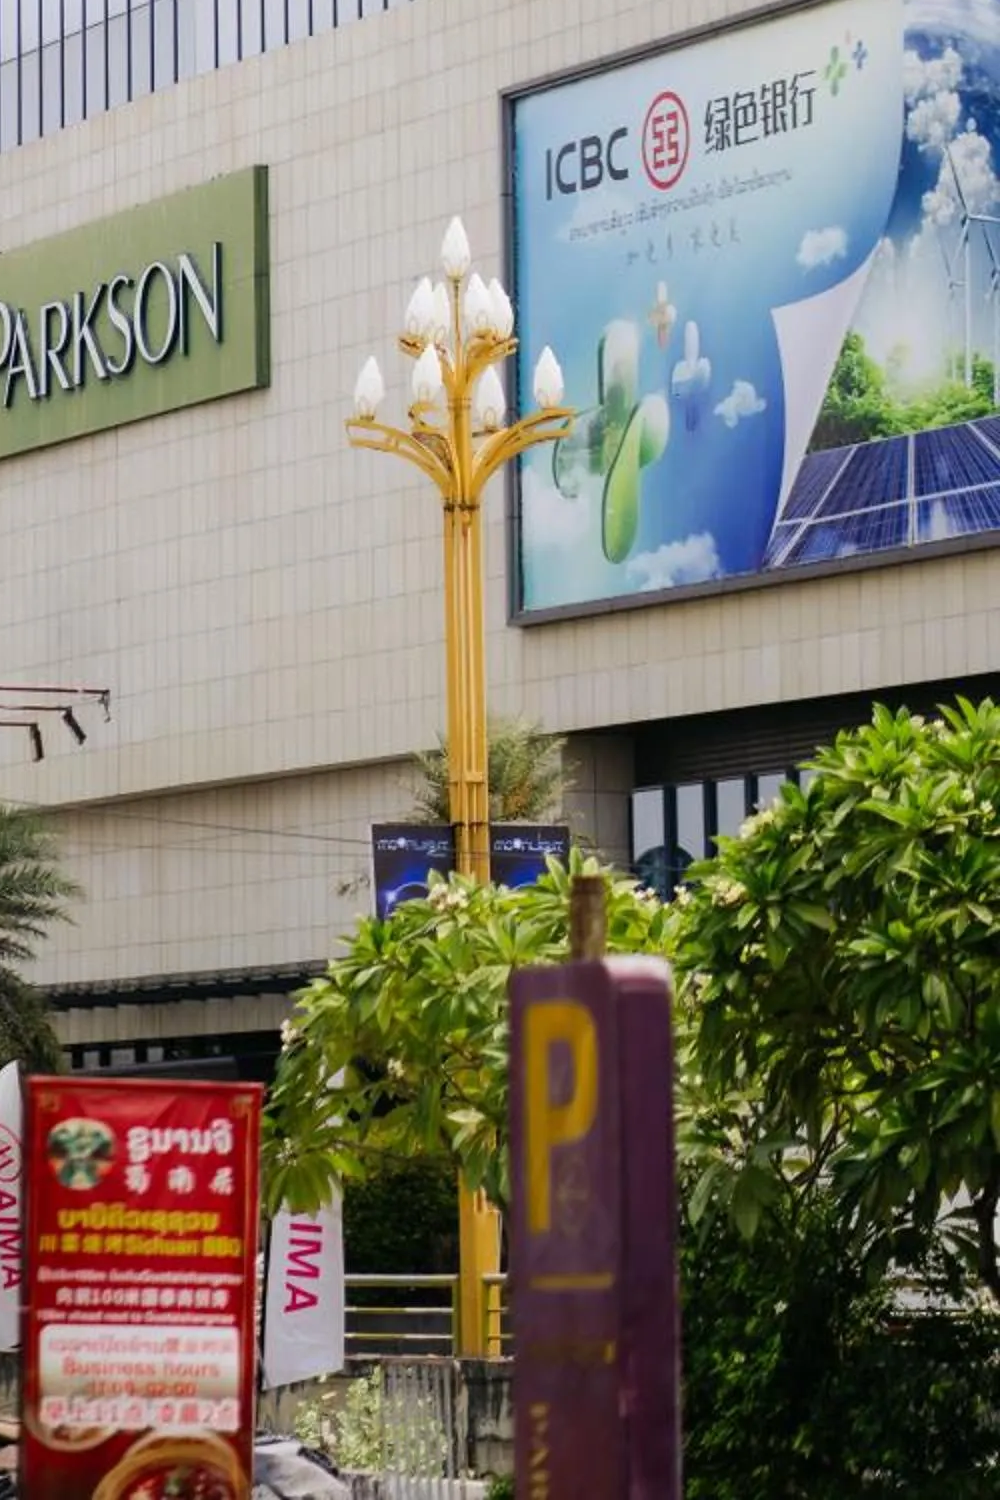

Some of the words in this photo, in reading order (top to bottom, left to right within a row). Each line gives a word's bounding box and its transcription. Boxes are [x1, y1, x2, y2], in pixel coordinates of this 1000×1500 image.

[704, 70, 818, 156] 绿色银行
[545, 126, 629, 201] ICBC
[525, 1001, 598, 1232] P
[283, 1223, 323, 1313] IMA
[62, 1356, 156, 1376] Business
[163, 1361, 221, 1377] hours
